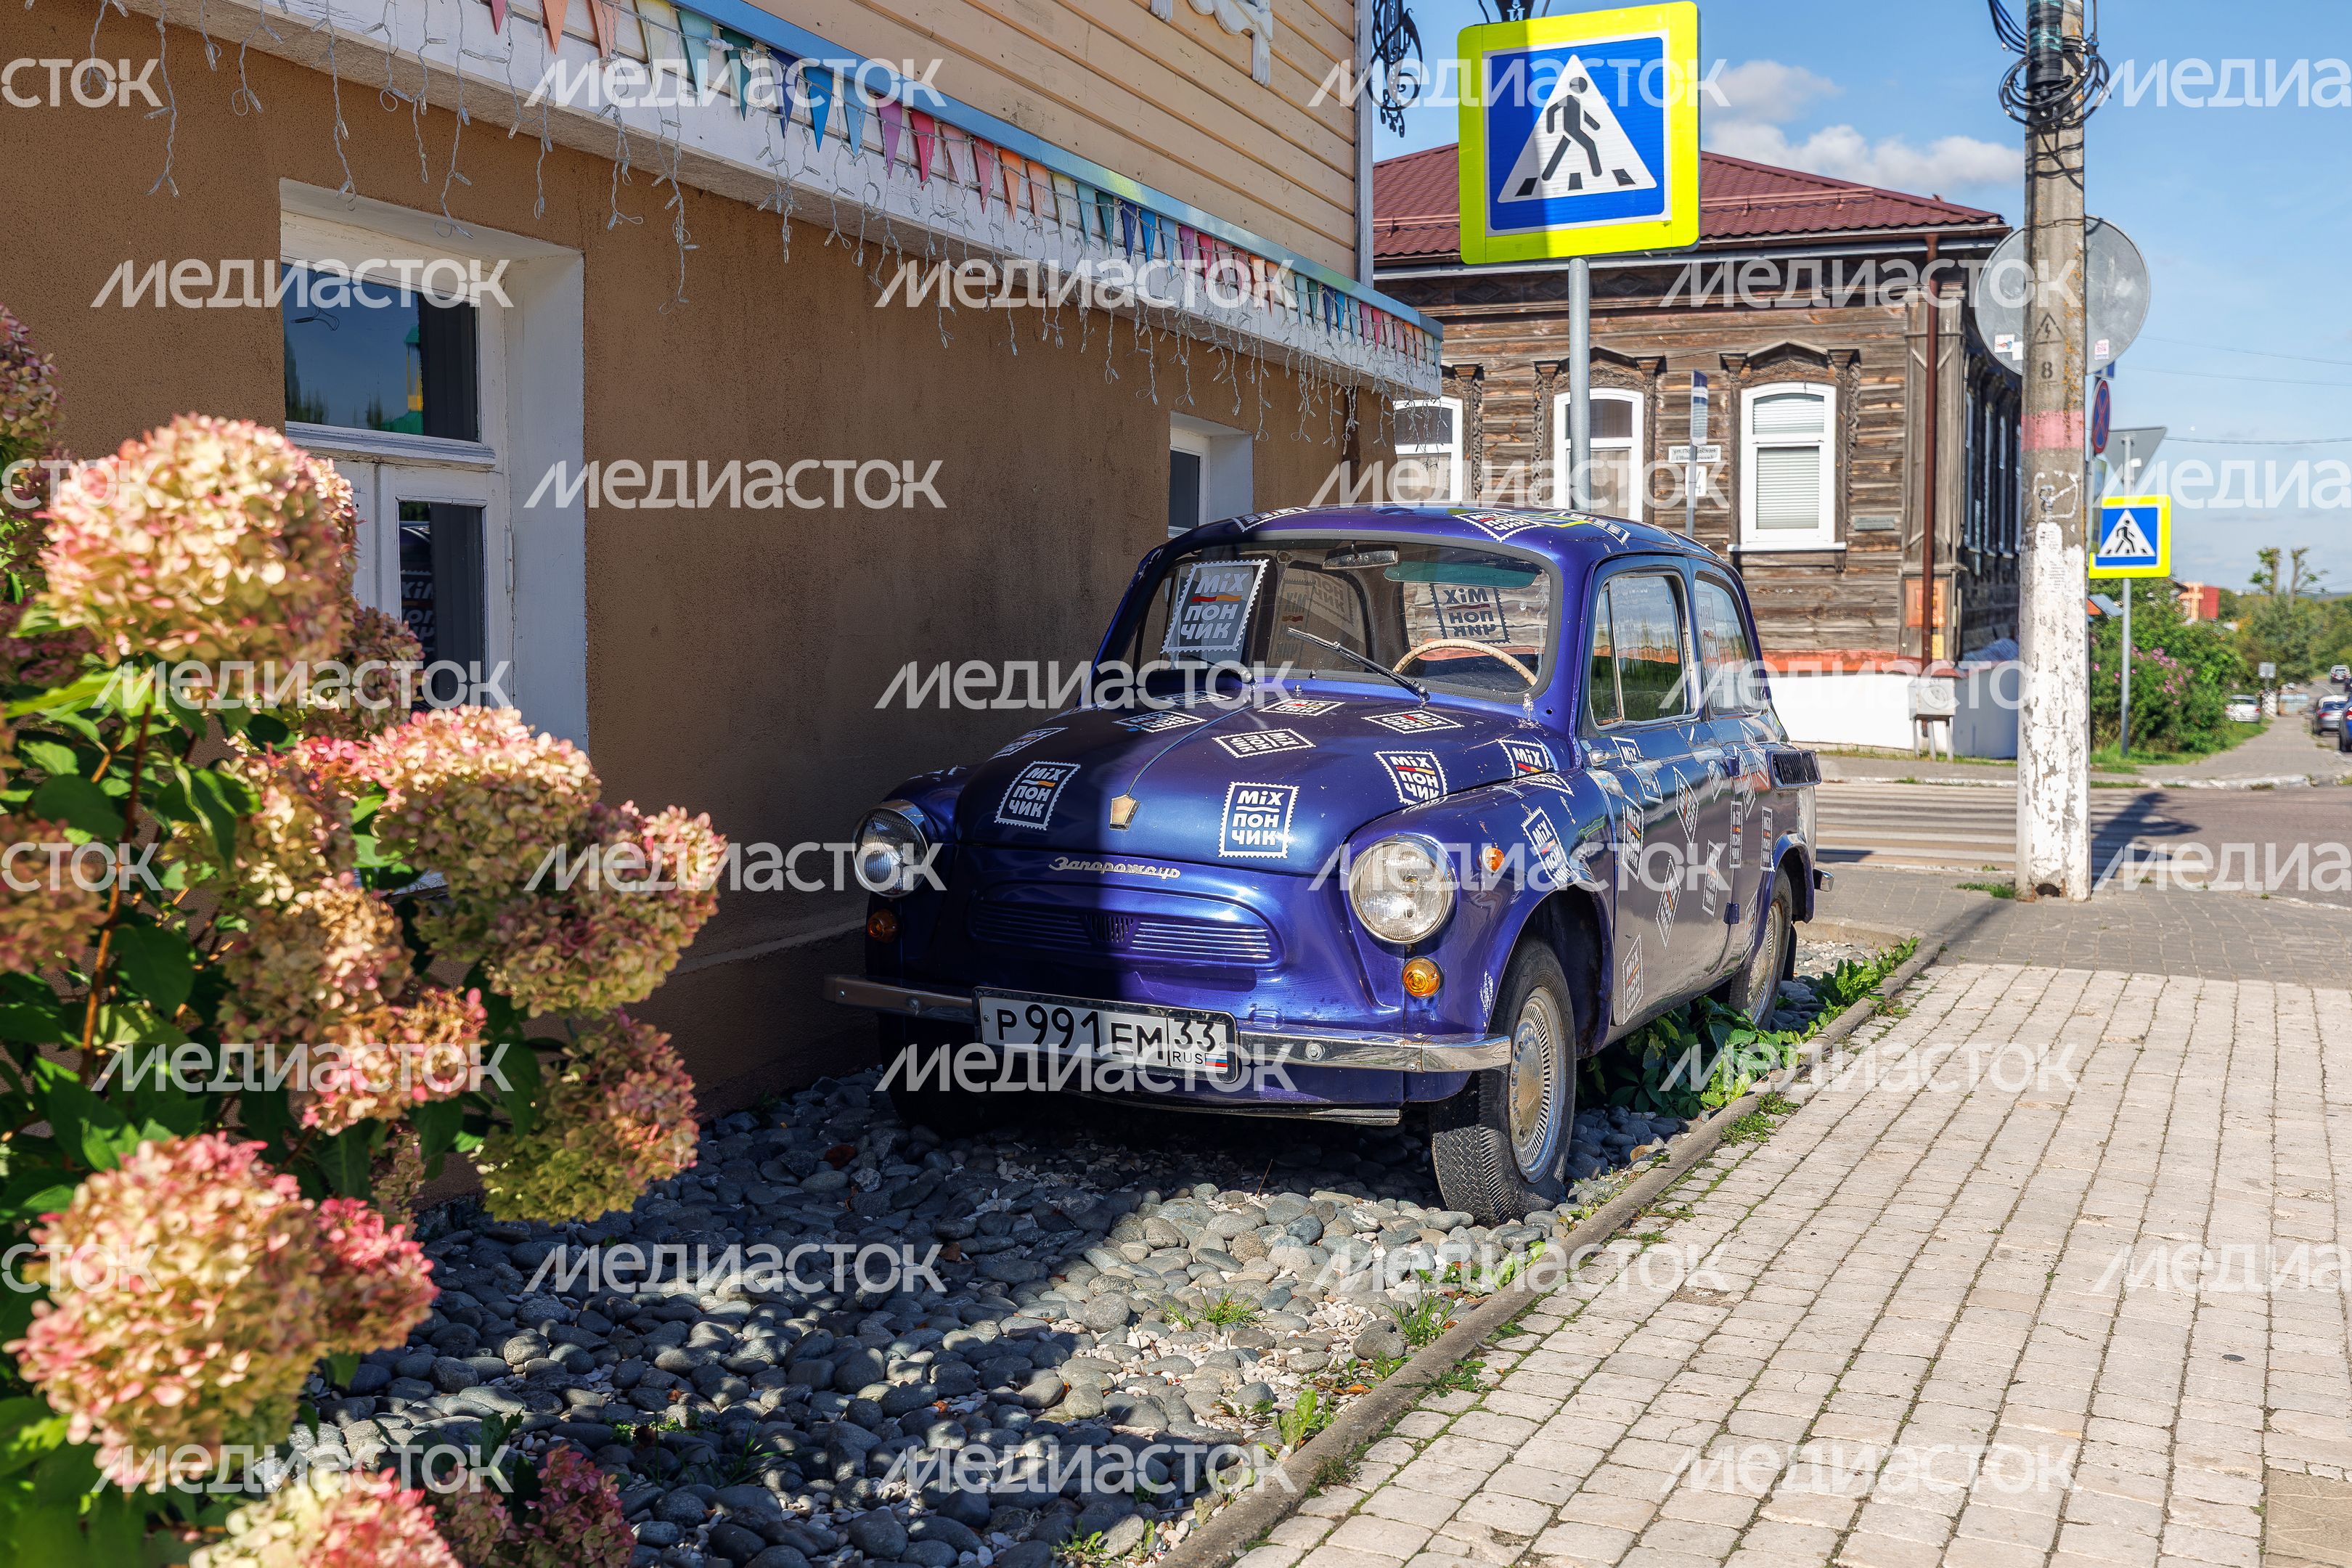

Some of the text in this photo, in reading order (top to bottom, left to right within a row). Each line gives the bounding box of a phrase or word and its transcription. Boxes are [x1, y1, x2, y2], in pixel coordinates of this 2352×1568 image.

[2041, 362, 2053, 379] 8
[1195, 572, 1249, 594] MiX
[1185, 604, 1238, 621] ПОН
[1181, 622, 1232, 640] ЧИК
[1230, 738, 1257, 753] ЧИК
[1244, 735, 1272, 750] ПОН
[1267, 732, 1299, 746] MiX
[1389, 755, 1429, 768] MiX
[1512, 747, 1543, 767] MiX
[1026, 767, 1067, 781] MiX
[1400, 772, 1440, 788] ПОН
[1013, 785, 1052, 802] ПОН
[1237, 791, 1285, 806] MiX
[1008, 799, 1045, 817] ЧИК
[1232, 813, 1280, 828] ПОН
[1626, 804, 1641, 830] MiX
[1231, 830, 1277, 846] ЧИК
[1532, 820, 1553, 848] MiX
[1626, 829, 1640, 854] ПОН
[1545, 846, 1563, 872] ПОН
[1626, 947, 1639, 981] MiX
[1626, 971, 1640, 1000] ПОН
[1174, 1019, 1216, 1052] 33
[1173, 1052, 1203, 1064] RUS
